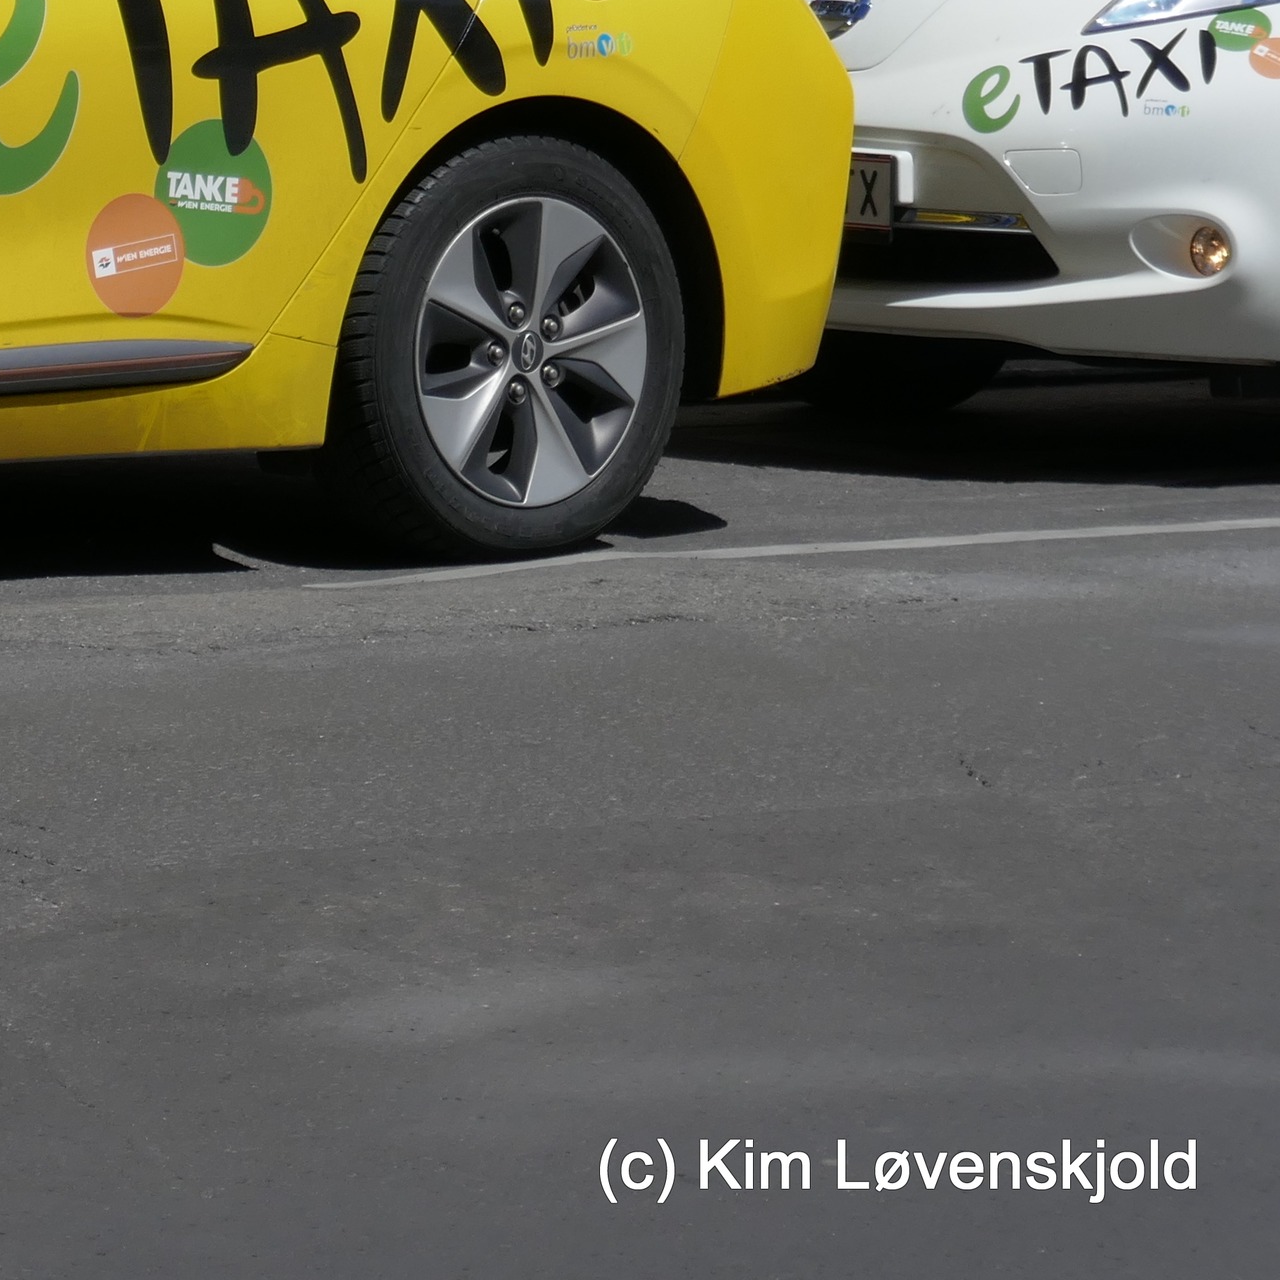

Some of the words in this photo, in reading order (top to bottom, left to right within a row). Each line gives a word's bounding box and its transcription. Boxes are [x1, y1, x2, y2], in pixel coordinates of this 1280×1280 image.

[1215, 20, 1256, 35] TANKE
[167, 171, 240, 204] TANKE
[177, 200, 199, 211] WIEN
[200, 203, 233, 213] ENERGIE
[117, 252, 138, 264] WIEN
[139, 244, 172, 258] ENERGIE
